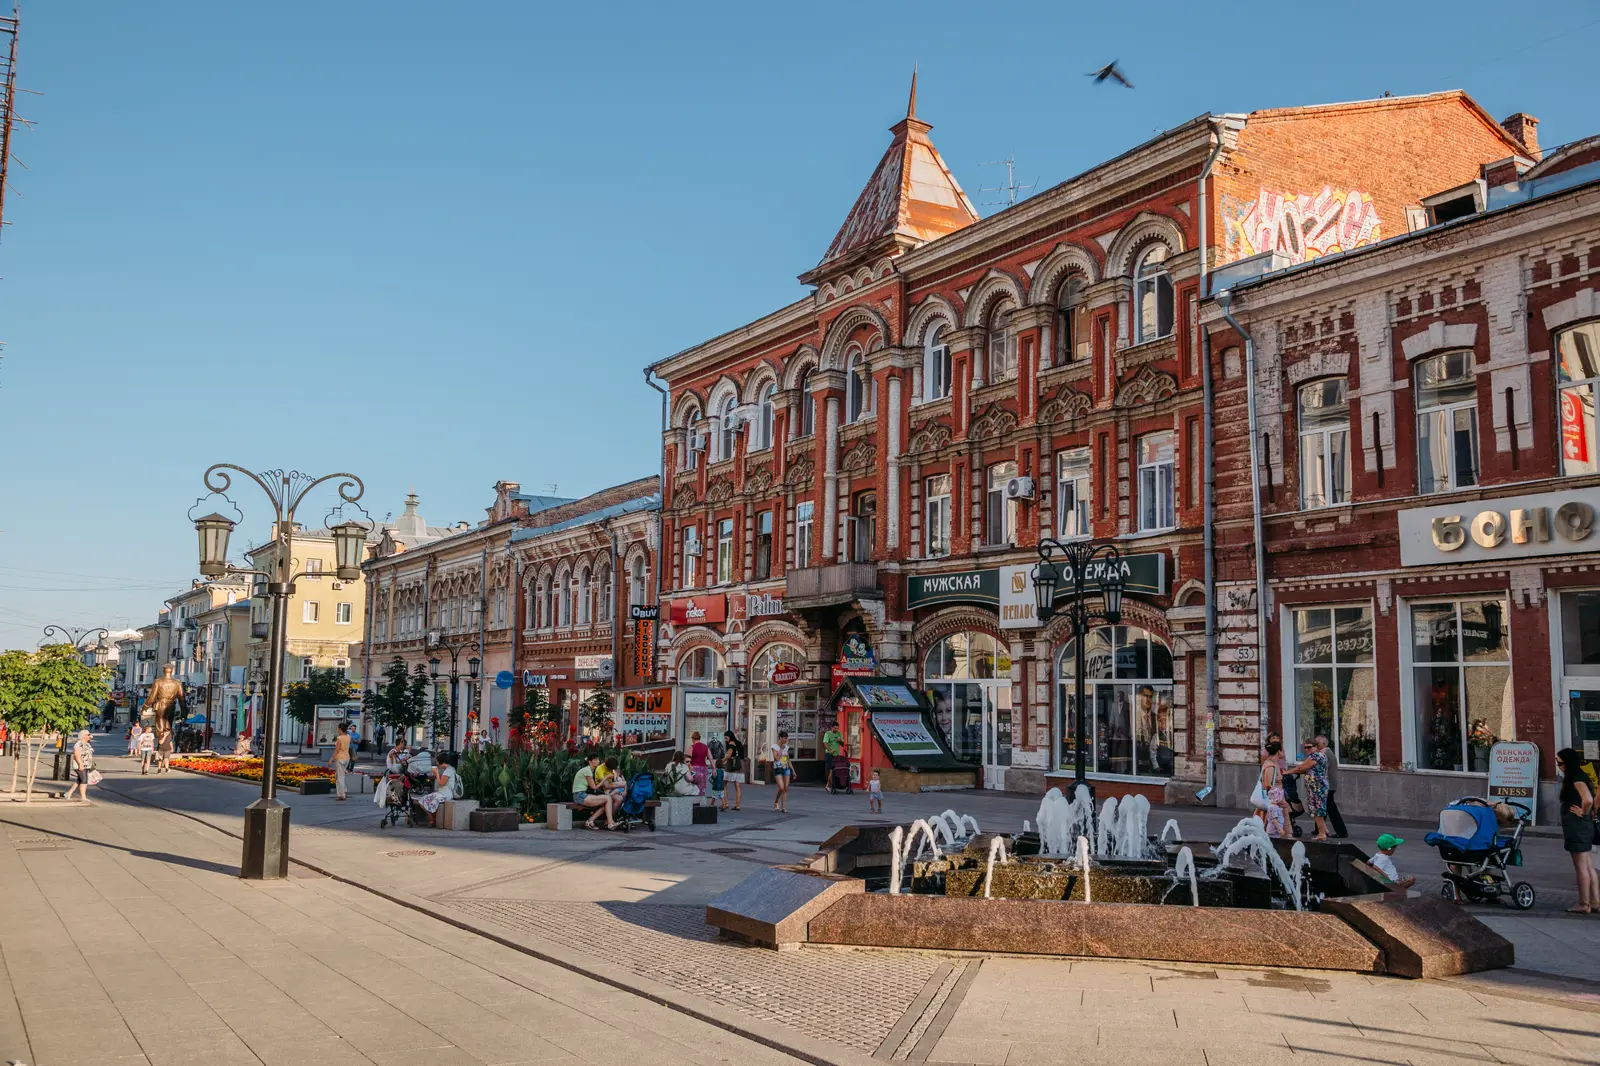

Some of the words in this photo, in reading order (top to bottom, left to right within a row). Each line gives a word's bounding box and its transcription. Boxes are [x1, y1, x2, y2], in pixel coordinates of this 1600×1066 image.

[923, 574, 981, 593] МУЖСКАЯ
[632, 606, 657, 618] OBUV
[749, 594, 787, 617] Palm
[1003, 604, 1035, 620] ПЕПЛОС
[1238, 648, 1250, 659] 53
[624, 696, 664, 712] OBUV
[1497, 787, 1527, 796] INESS
